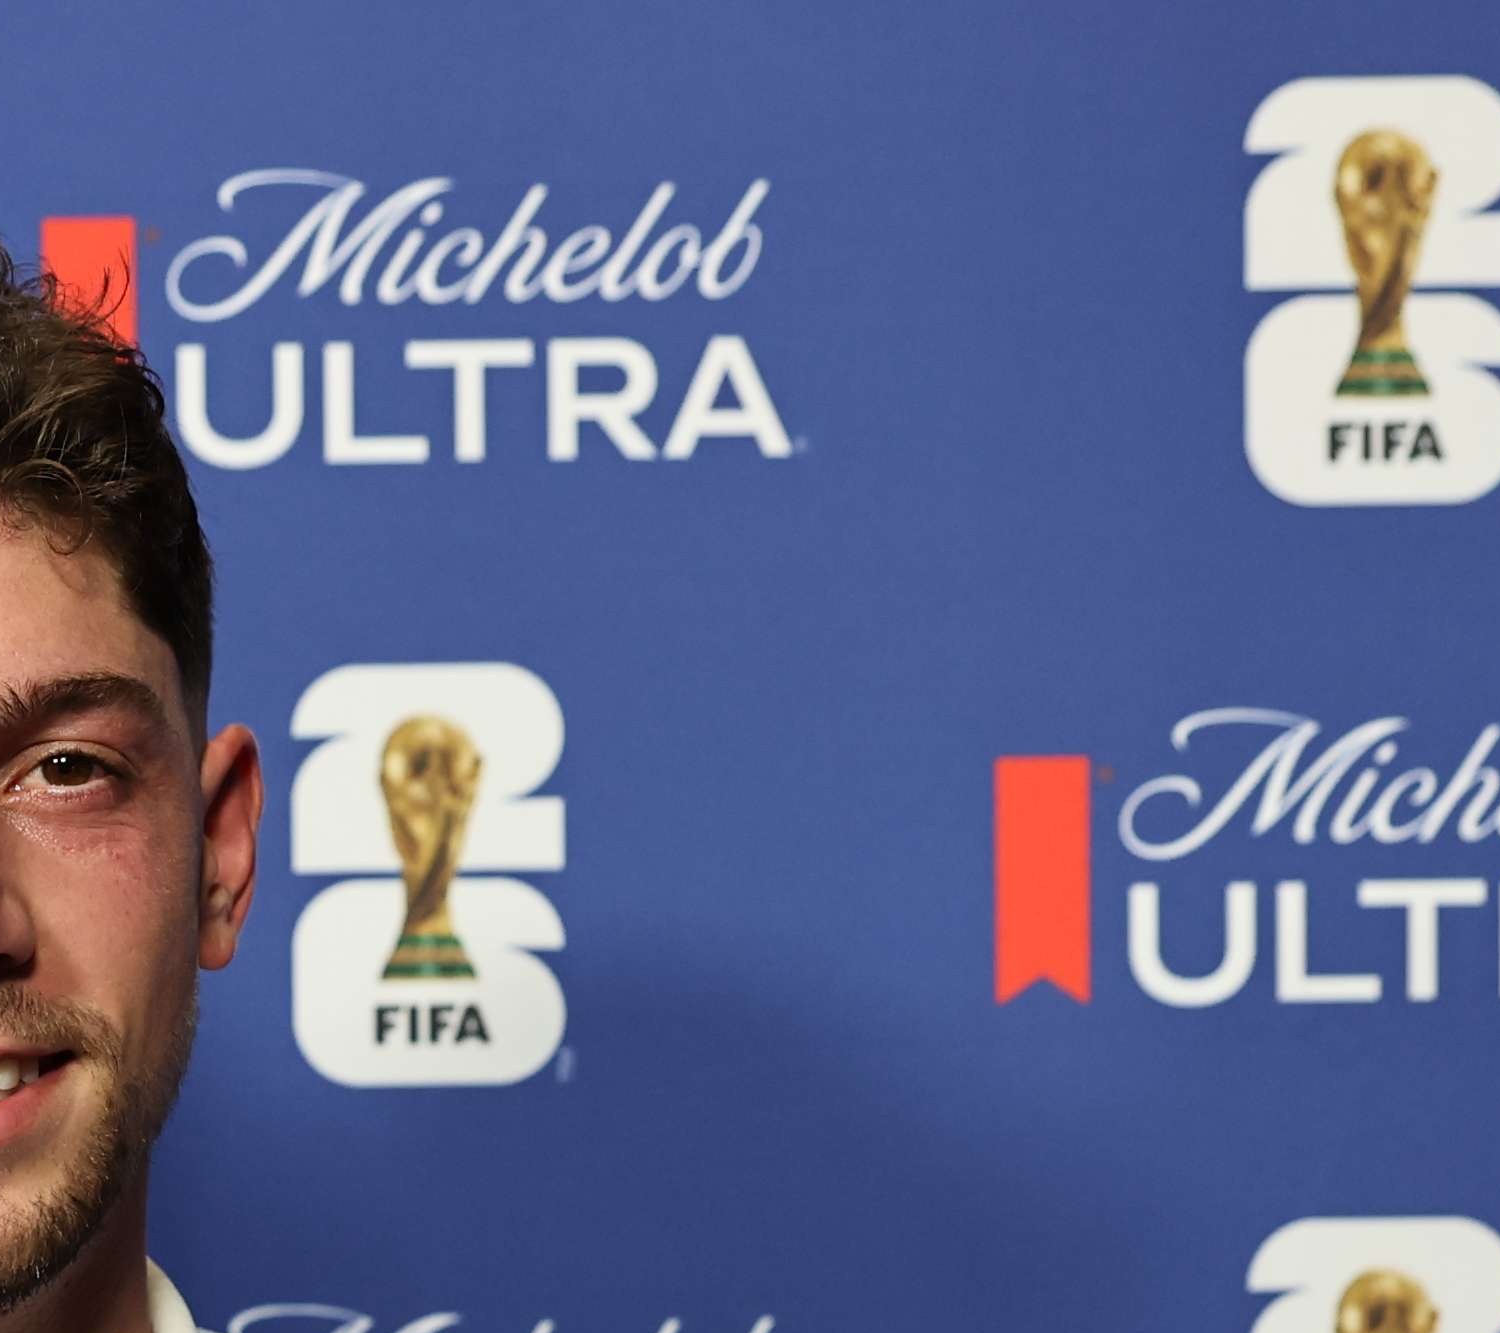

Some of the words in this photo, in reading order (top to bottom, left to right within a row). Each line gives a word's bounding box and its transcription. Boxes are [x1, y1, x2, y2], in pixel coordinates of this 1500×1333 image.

[165, 168, 769, 323] Michelob
[174, 334, 793, 471] ULTRA
[1326, 420, 1445, 464] FIFA
[373, 1002, 492, 1047] FIFA
